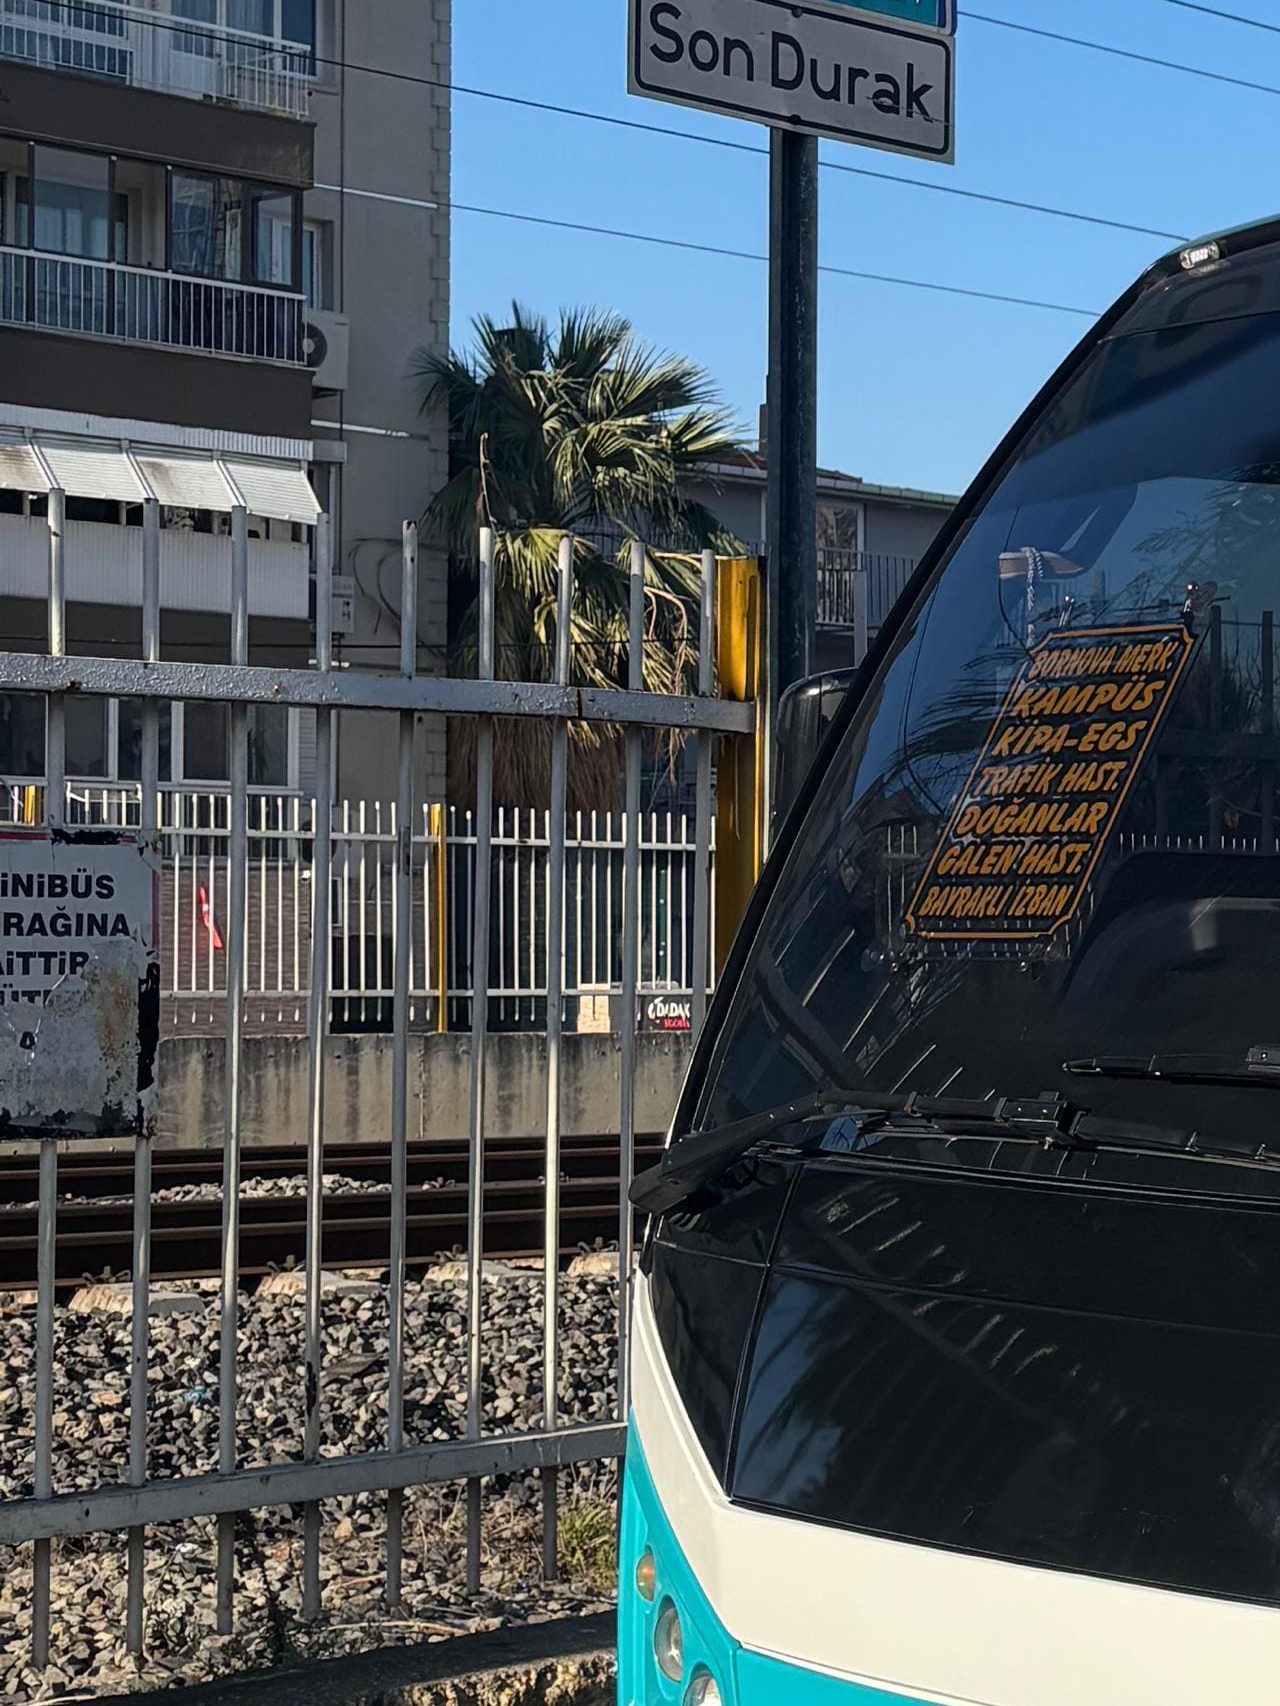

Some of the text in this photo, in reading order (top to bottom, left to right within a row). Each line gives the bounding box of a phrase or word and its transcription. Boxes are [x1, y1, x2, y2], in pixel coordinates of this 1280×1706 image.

[649, 2, 935, 123] Son Durak
[1012, 677, 1163, 718] KAMPÜS
[991, 719, 1147, 756] KİPA-EGS
[974, 758, 1126, 796] TRAFİK HAST.
[955, 798, 1108, 836] DOĞANLAR
[936, 842, 1090, 876] GALEN HAST.
[918, 886, 1007, 917] BAYRAKLI
